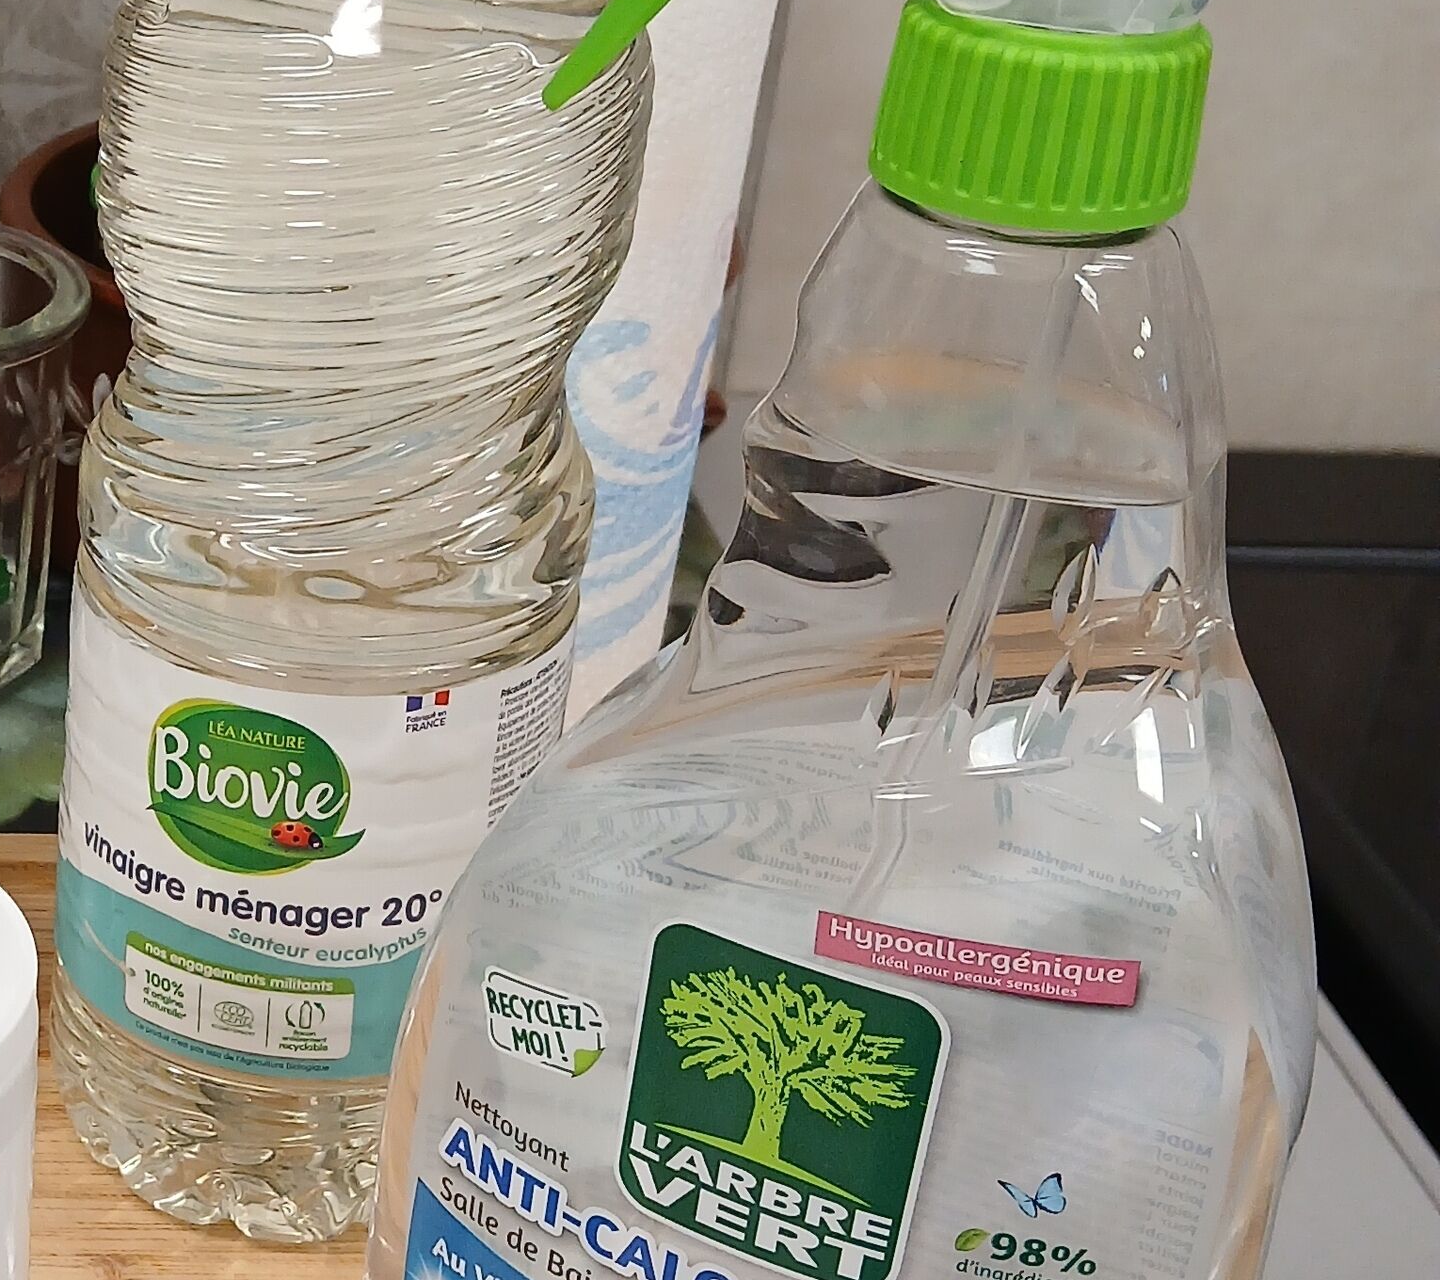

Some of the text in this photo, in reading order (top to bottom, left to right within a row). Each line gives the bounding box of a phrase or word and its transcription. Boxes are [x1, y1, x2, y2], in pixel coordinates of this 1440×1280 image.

[207, 720, 306, 751] LÉA NATURE
[405, 718, 446, 734] FRANCE
[154, 725, 349, 821] Biovie
[84, 820, 442, 936] vinaigre ménager 20°
[144, 941, 335, 993] nos engagements militants
[228, 924, 427, 964] senteur eucalyptus
[828, 917, 1126, 987] Hypoallergénique
[145, 969, 184, 997] 100%
[871, 952, 1080, 999] Idéal pour peaux sensibles
[455, 1080, 570, 1173] Nettoyant
[629, 1120, 893, 1246] L'ARBRE
[440, 1175, 499, 1236] Salle
[506, 1227, 539, 1263] de
[628, 1153, 886, 1280] VERT
[431, 1237, 468, 1278] Au
[990, 1231, 1098, 1276] 98%
